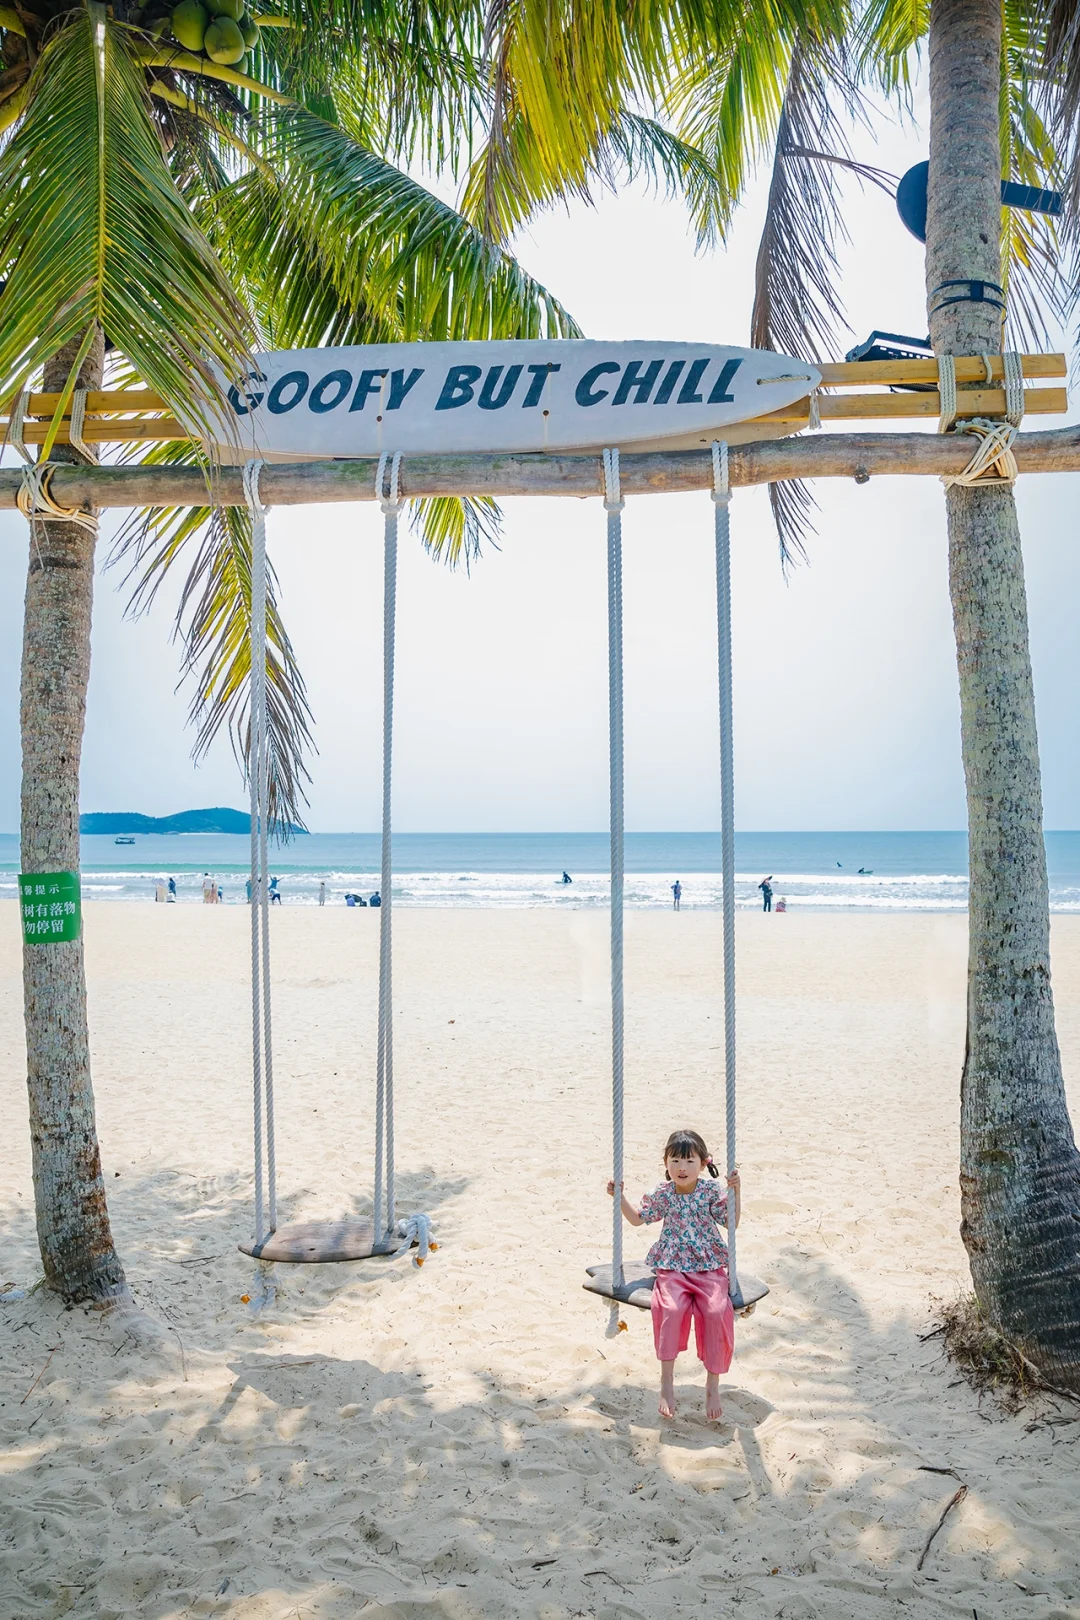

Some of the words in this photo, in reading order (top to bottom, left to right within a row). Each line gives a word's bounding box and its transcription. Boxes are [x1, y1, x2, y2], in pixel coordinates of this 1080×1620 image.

[227, 368, 425, 416] GOOFY
[435, 363, 561, 411] BUT
[576, 358, 744, 406] CHILL
[23, 919, 64, 934] 勿停留
